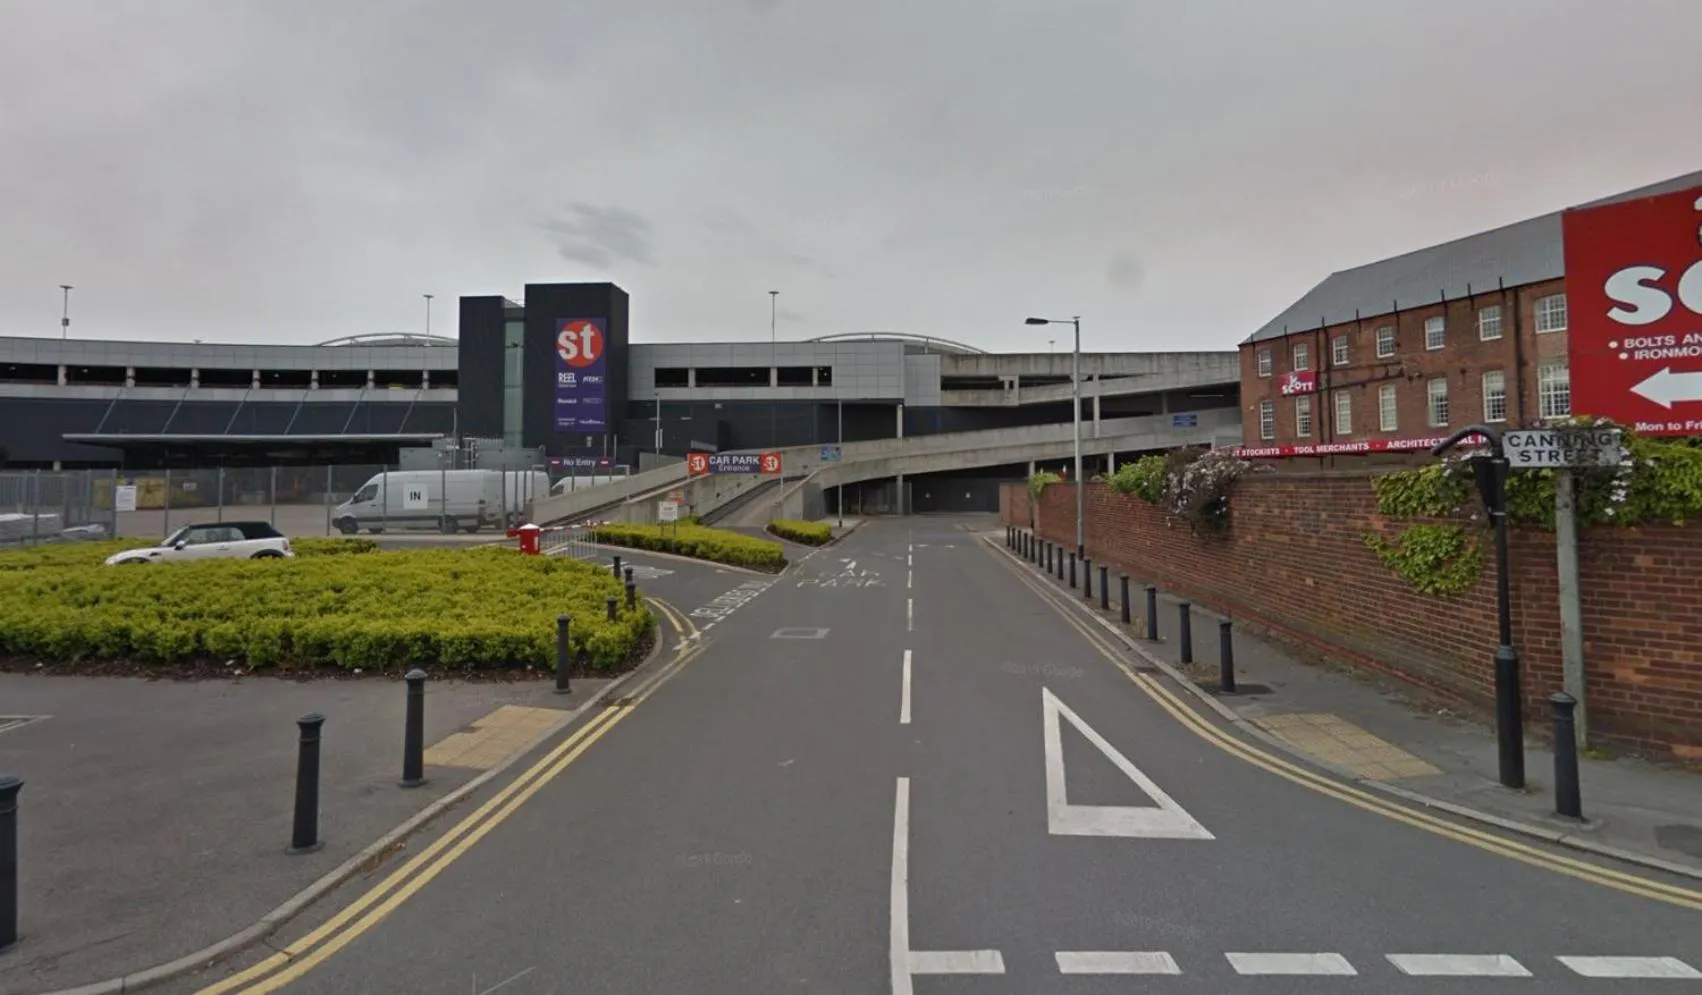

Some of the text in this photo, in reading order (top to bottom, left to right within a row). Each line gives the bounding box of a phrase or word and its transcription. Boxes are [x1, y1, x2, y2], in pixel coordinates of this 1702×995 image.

[558, 322, 596, 361] st
[1623, 335, 1676, 350] BOLTS
[1281, 381, 1313, 394] SCOTT
[1635, 421, 1664, 432] Mon
[1667, 421, 1682, 432] to
[1294, 445, 1315, 455] TOOL
[1315, 441, 1370, 453] MERCHANTS
[709, 455, 731, 465] CAR
[732, 455, 760, 465] PARK
[410, 491, 421, 501] IN
